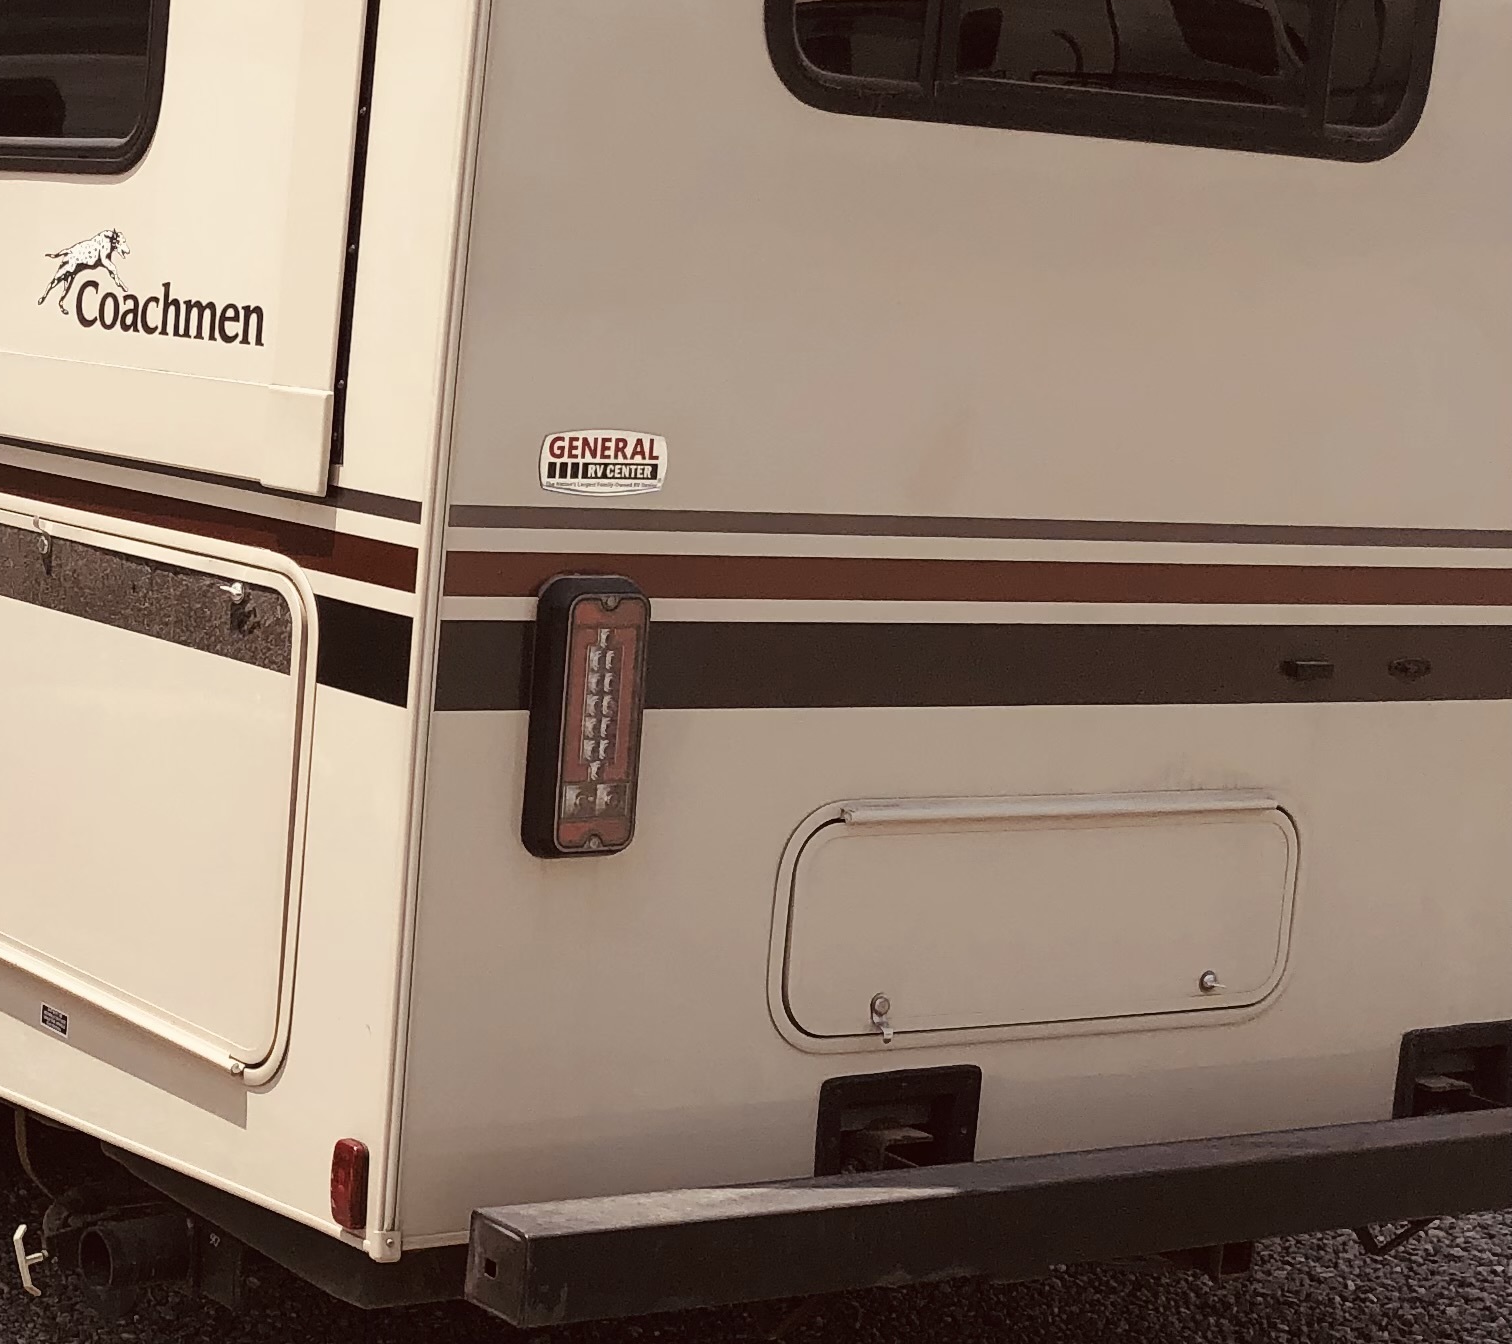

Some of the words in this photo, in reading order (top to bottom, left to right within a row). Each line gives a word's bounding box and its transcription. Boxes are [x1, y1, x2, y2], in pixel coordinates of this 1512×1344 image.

[75, 279, 265, 347] Coachmen
[548, 435, 660, 461] GENERAL
[588, 464, 605, 478] RV
[606, 464, 653, 479] CENTER
